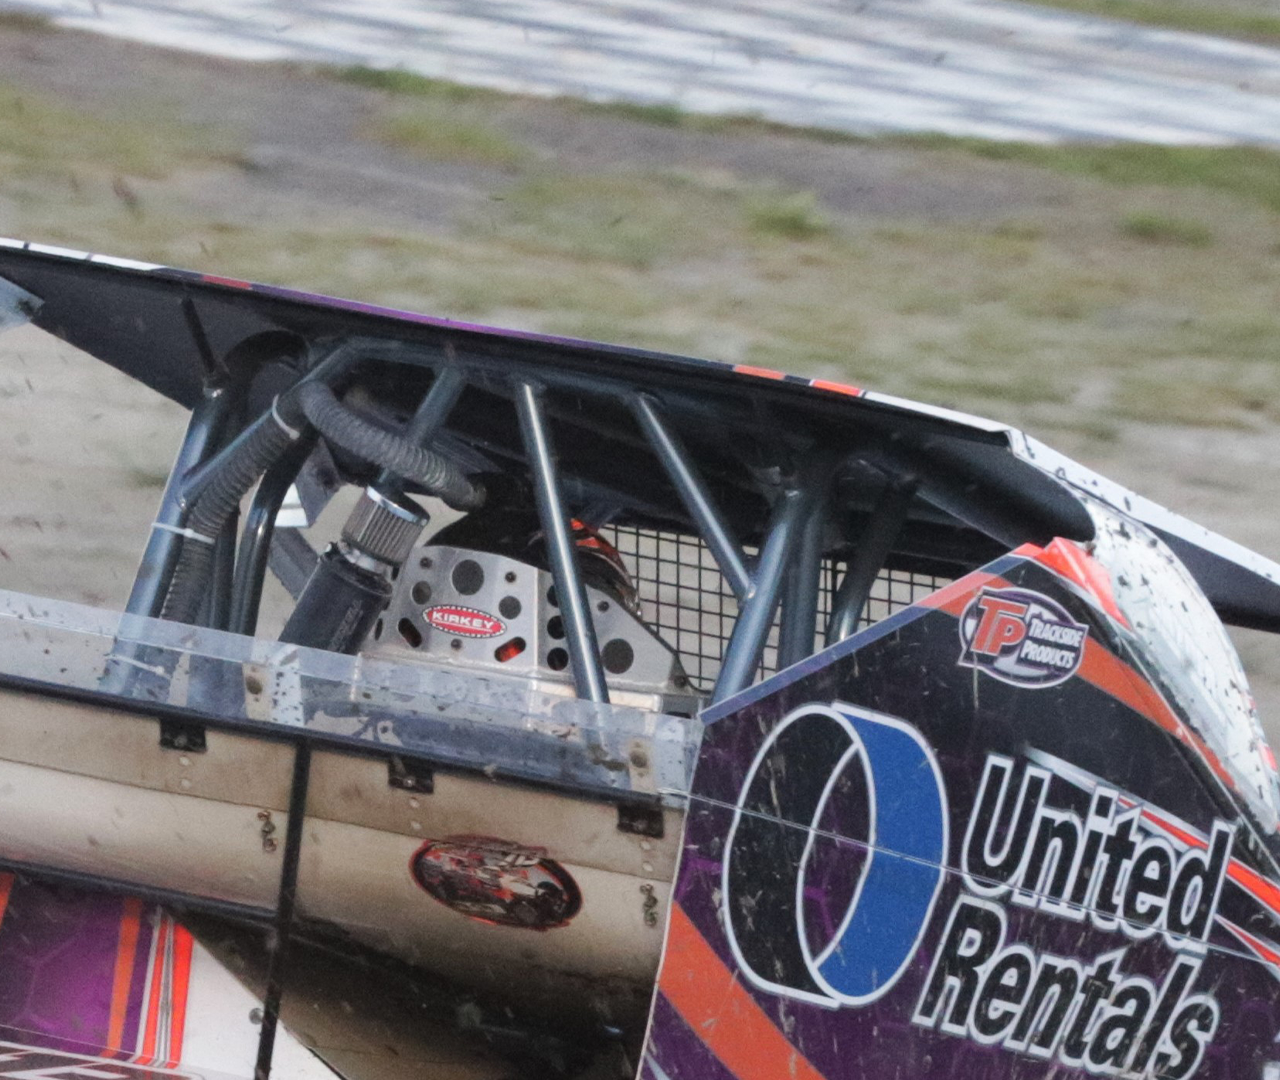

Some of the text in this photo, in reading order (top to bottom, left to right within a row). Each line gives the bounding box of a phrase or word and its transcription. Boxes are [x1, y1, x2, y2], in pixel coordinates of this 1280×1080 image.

[431, 610, 495, 631] KIRKEY
[1028, 617, 1083, 648] TRACKSIDE
[1020, 640, 1076, 669] PRODUCTS
[960, 753, 1237, 951] United
